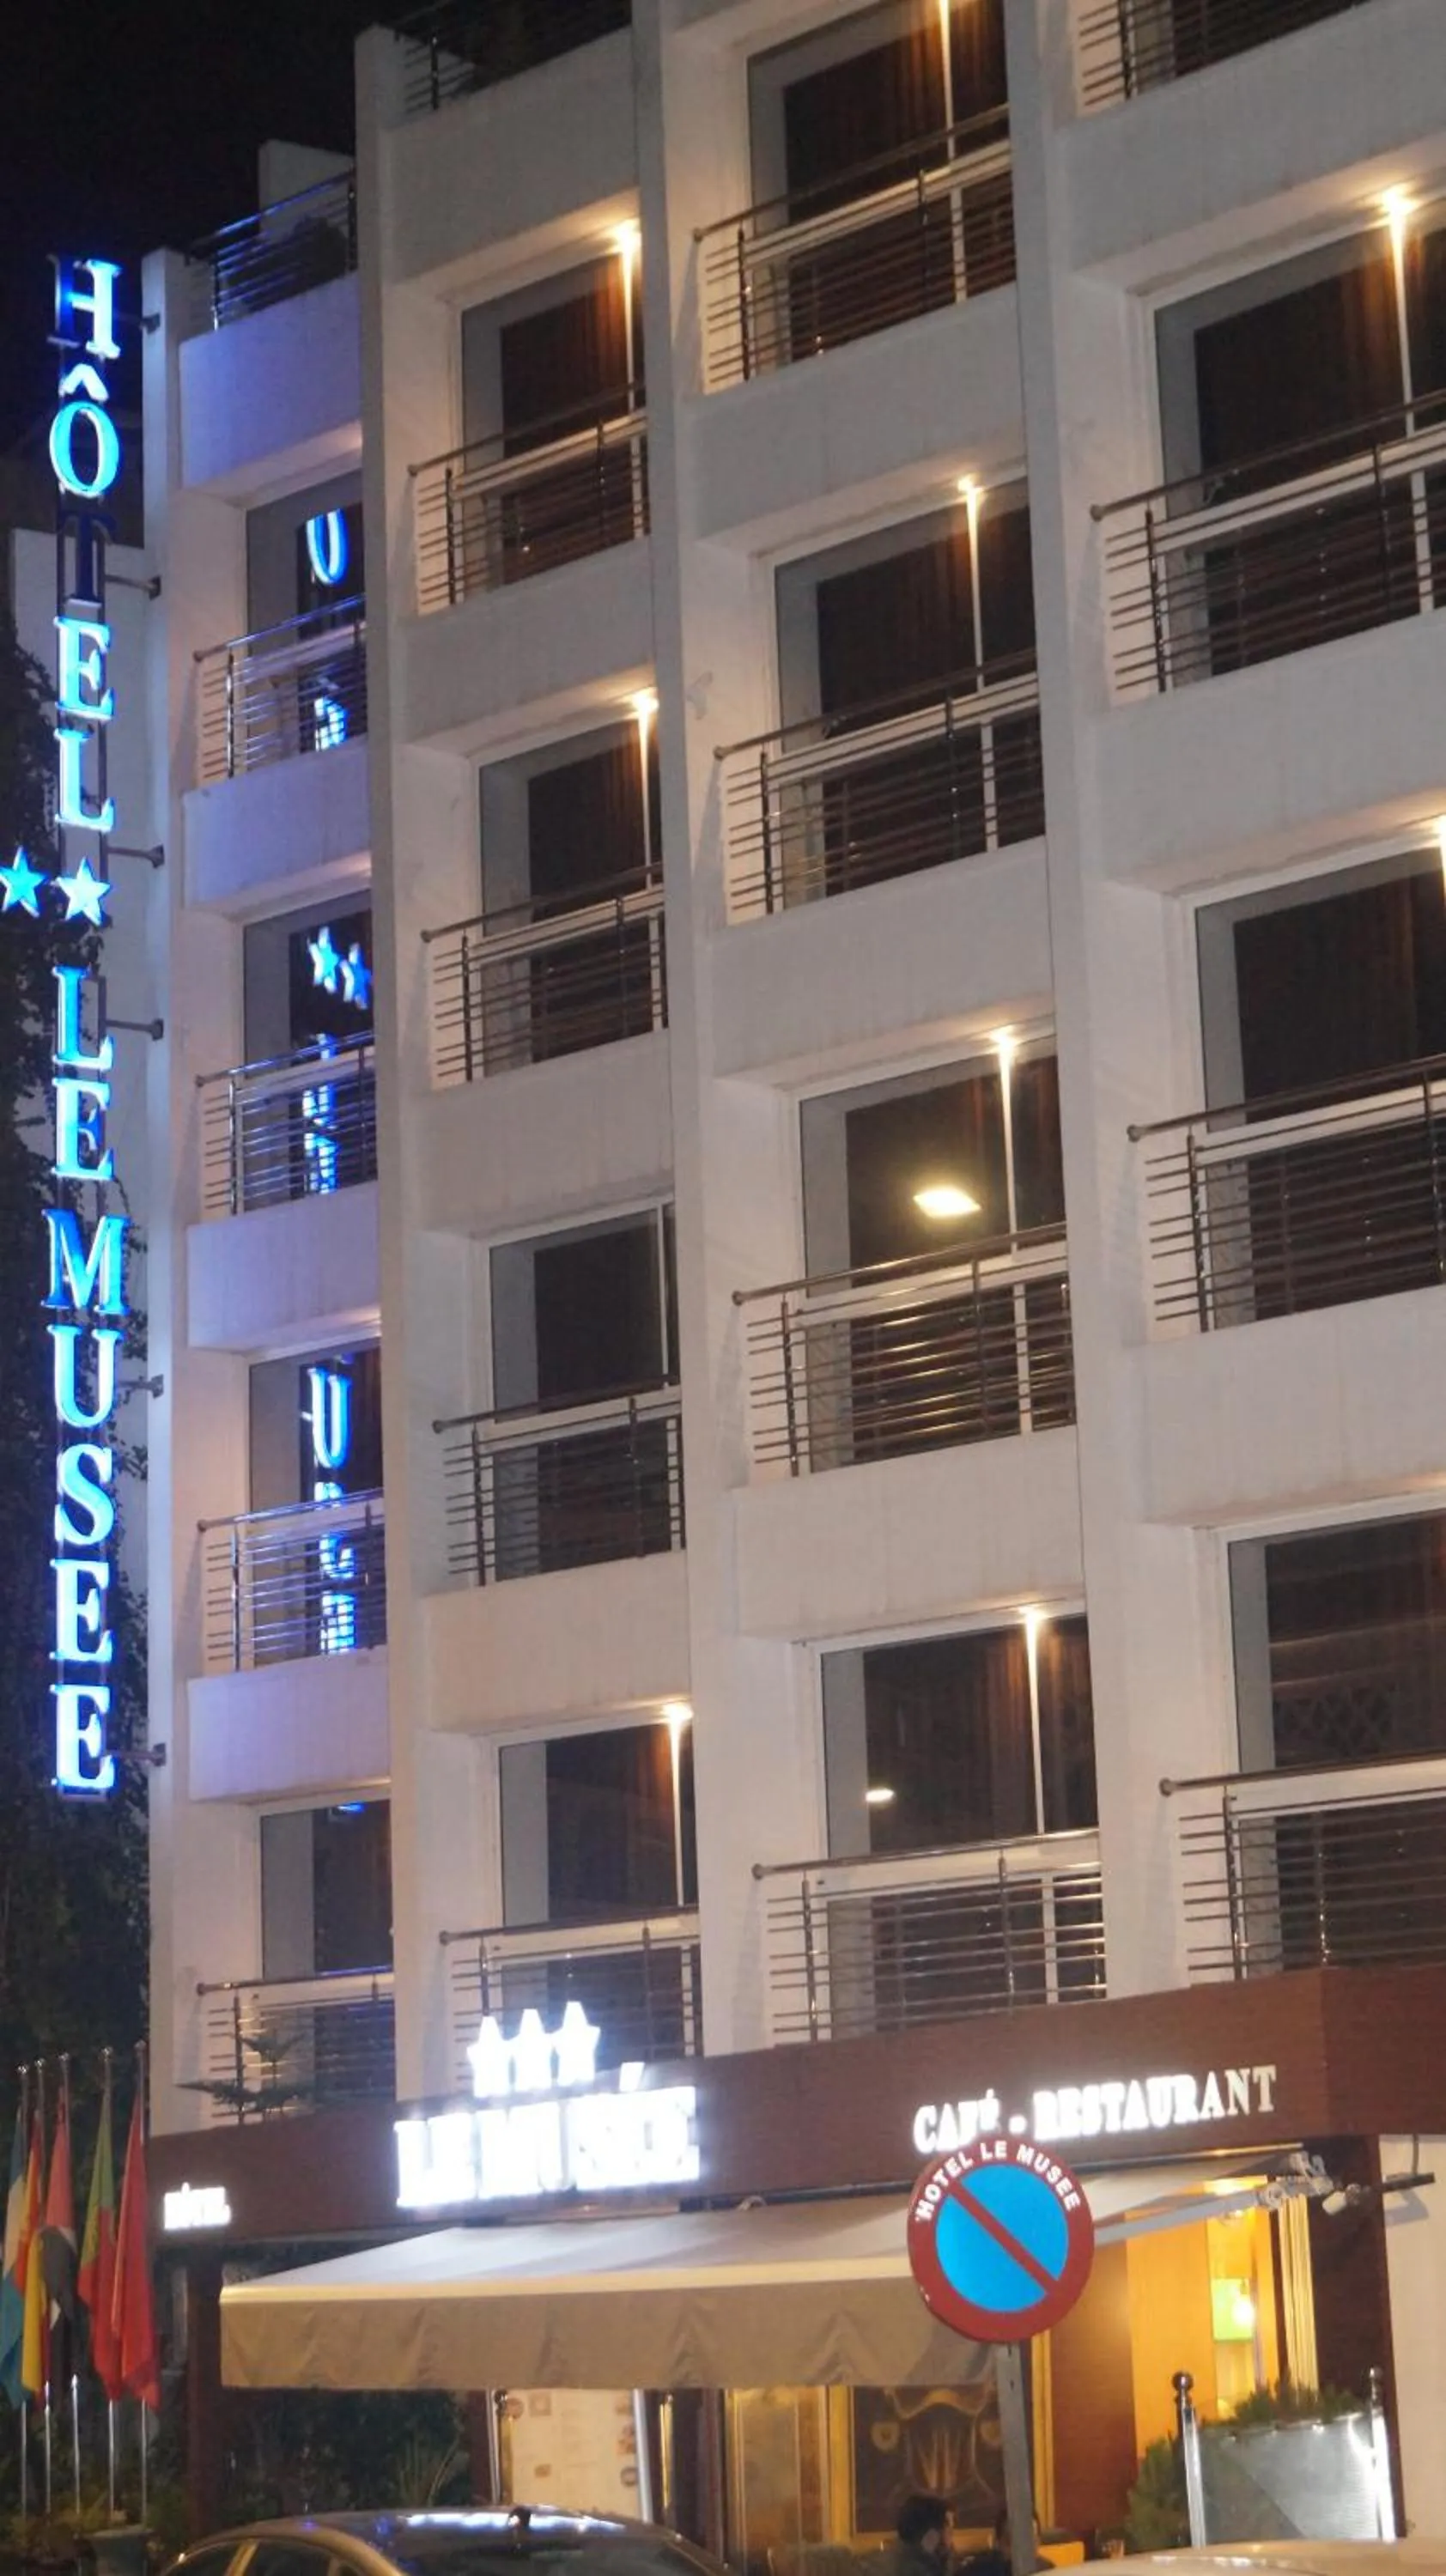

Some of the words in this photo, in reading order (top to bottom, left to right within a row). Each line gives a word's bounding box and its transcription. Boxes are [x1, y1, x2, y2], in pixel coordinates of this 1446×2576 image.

[52, 965, 115, 1180] LE
[41, 1209, 131, 1789] MUSEE
[1033, 2065, 1277, 2141] RESTAURANT
[916, 2152, 974, 2221] HOTEL
[981, 2141, 1008, 2160] LE
[1018, 2144, 1081, 2211] MUSEE
